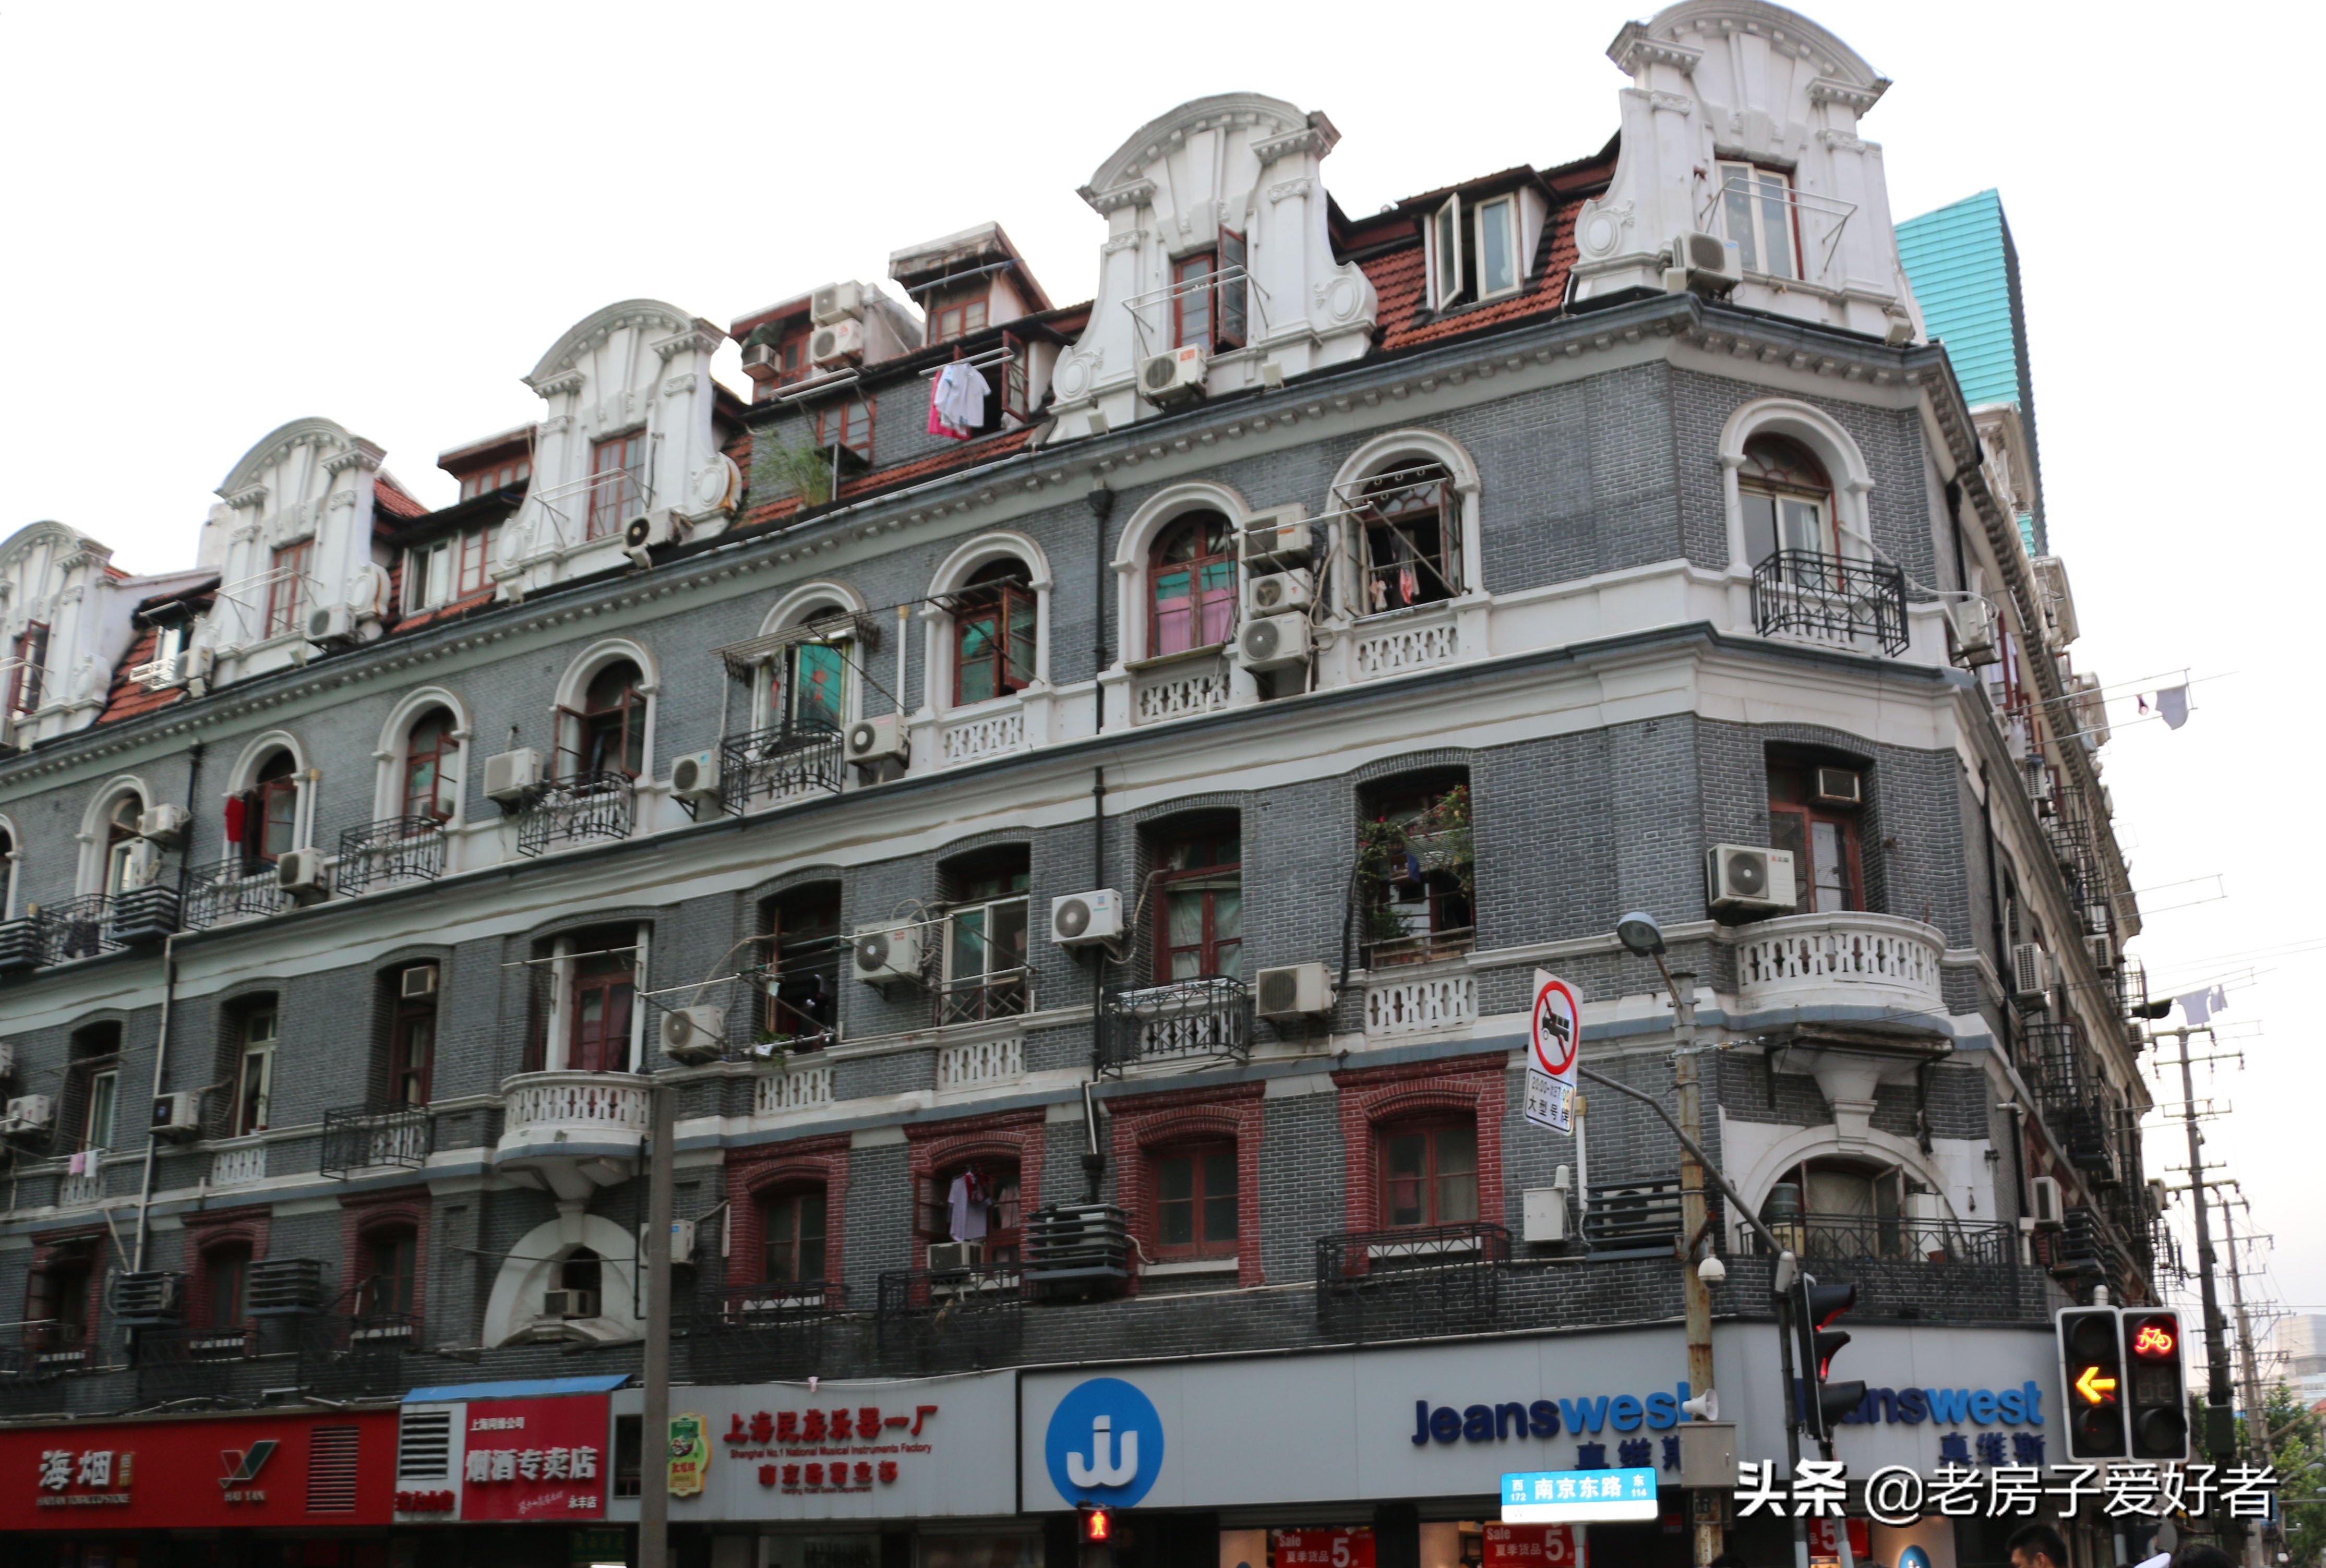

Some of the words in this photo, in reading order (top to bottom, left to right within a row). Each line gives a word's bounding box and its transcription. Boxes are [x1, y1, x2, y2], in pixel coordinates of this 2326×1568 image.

[723, 1405, 938, 1443] 上海民族乐器一厂
[730, 1448, 764, 1460] Shanghai
[767, 1448, 783, 1457] No.1
[786, 1446, 817, 1456] National
[820, 1445, 849, 1456] Musical
[852, 1444, 899, 1454] Instruments
[901, 1442, 932, 1454] Factory
[1939, 1431, 2045, 1466] 真维斯
[39, 1450, 113, 1490] 海烟
[465, 1446, 598, 1482] 烟酒专卖店
[759, 1461, 898, 1486] 南京路营业部
[1511, 1492, 1527, 1501] 172
[1631, 1488, 1647, 1497] 114
[1512, 1479, 1524, 1492] 西
[1534, 1476, 1622, 1500] 南京东路
[1633, 1474, 1645, 1487] 东
[1279, 1535, 1301, 1547] Sale
[1486, 1527, 1510, 1540] Sale
[1495, 1543, 1541, 1557] 夏季货品
[1545, 1529, 1564, 1561] 5
[1286, 1550, 1329, 1563] 夏季货品
[1333, 1537, 1350, 1567] 5
